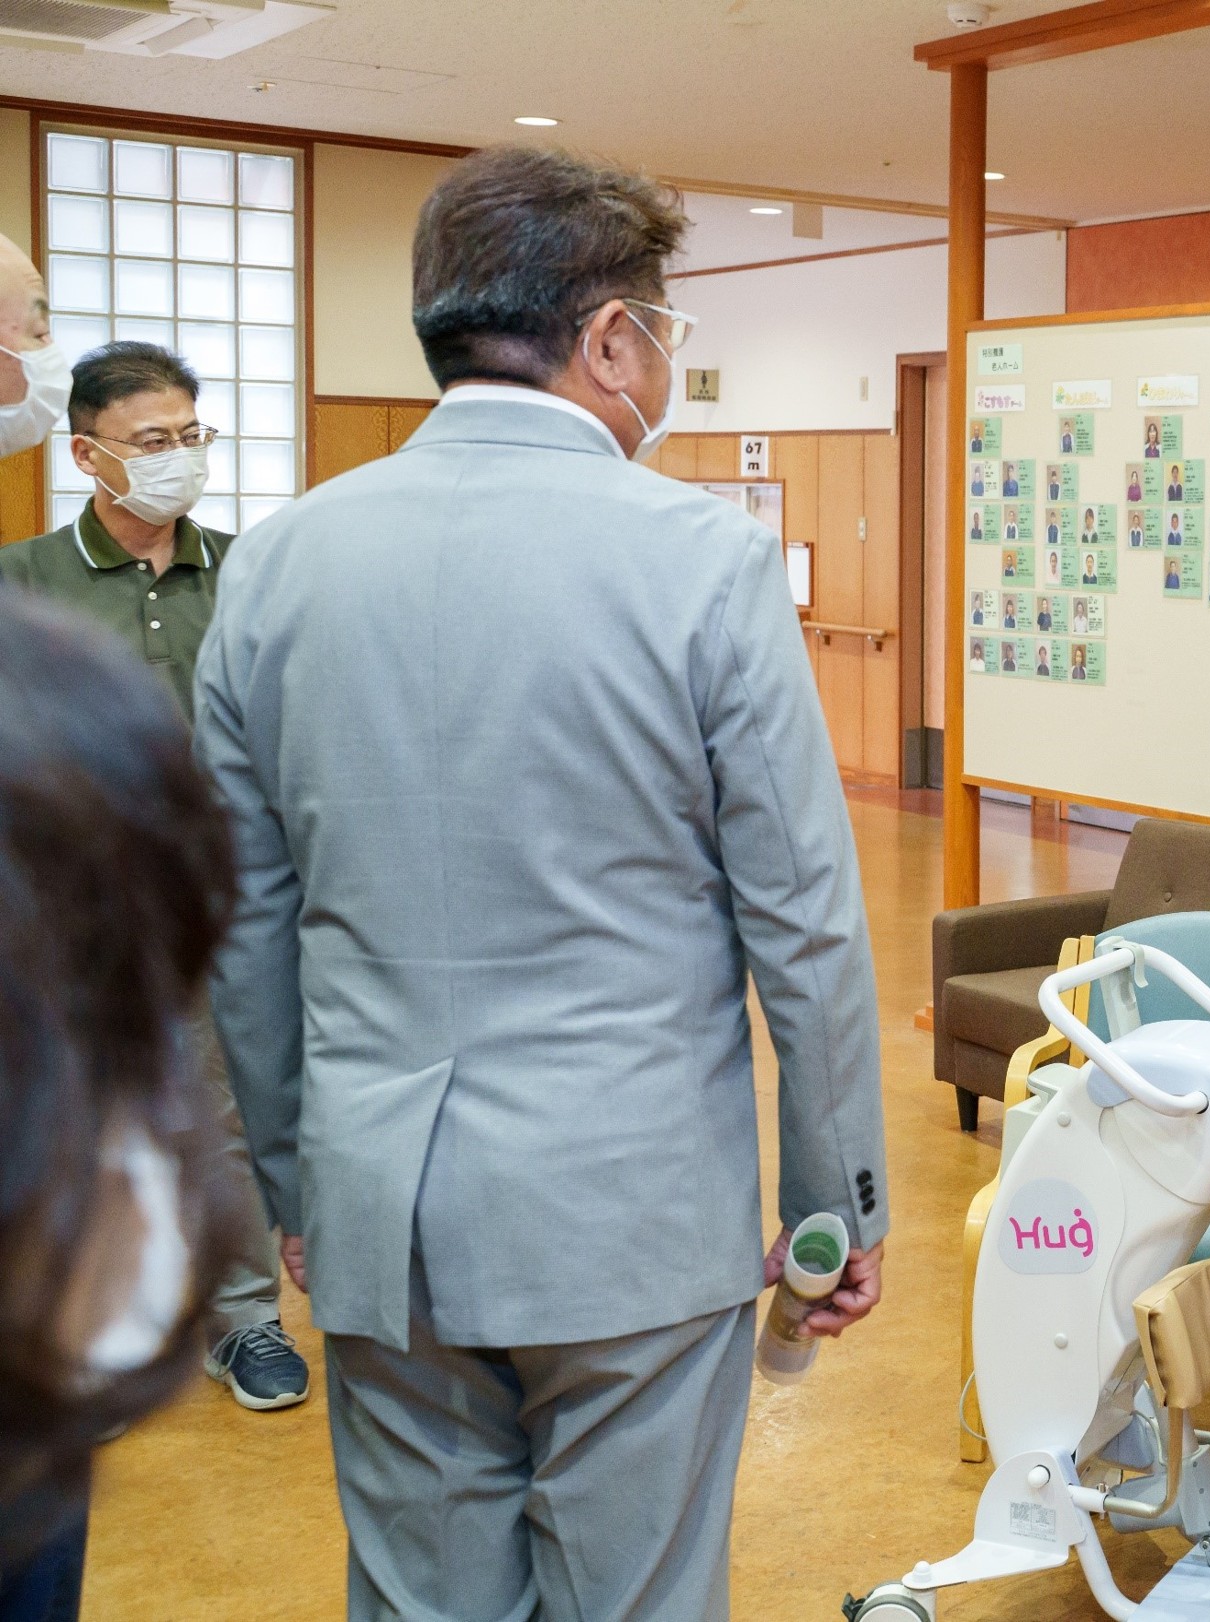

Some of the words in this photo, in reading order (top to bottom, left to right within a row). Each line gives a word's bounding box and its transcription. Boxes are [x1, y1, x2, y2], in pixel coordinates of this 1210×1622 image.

[745, 442, 762, 455] 67
[747, 461, 760, 471] m
[1009, 1208, 1094, 1257] Hug
